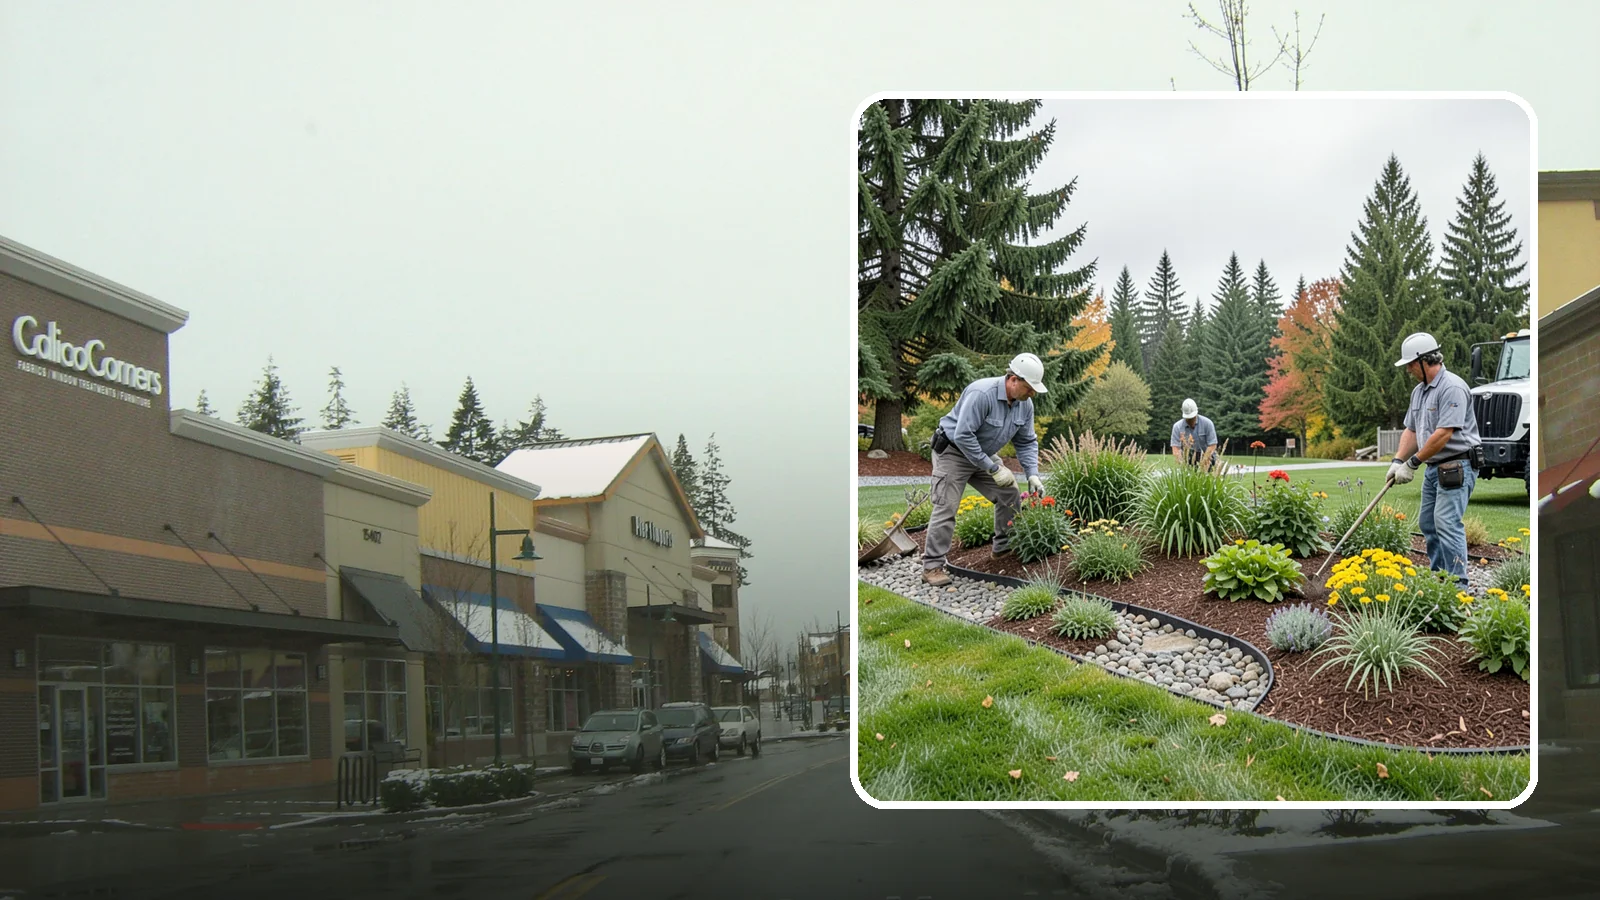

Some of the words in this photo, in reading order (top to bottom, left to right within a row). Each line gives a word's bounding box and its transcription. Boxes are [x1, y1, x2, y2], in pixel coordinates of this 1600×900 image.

[17, 360, 46, 377] FABRICS
[51, 371, 78, 386] WINDOW
[78, 378, 117, 398] TREATMENTS
[120, 391, 152, 409] FURNITURE
